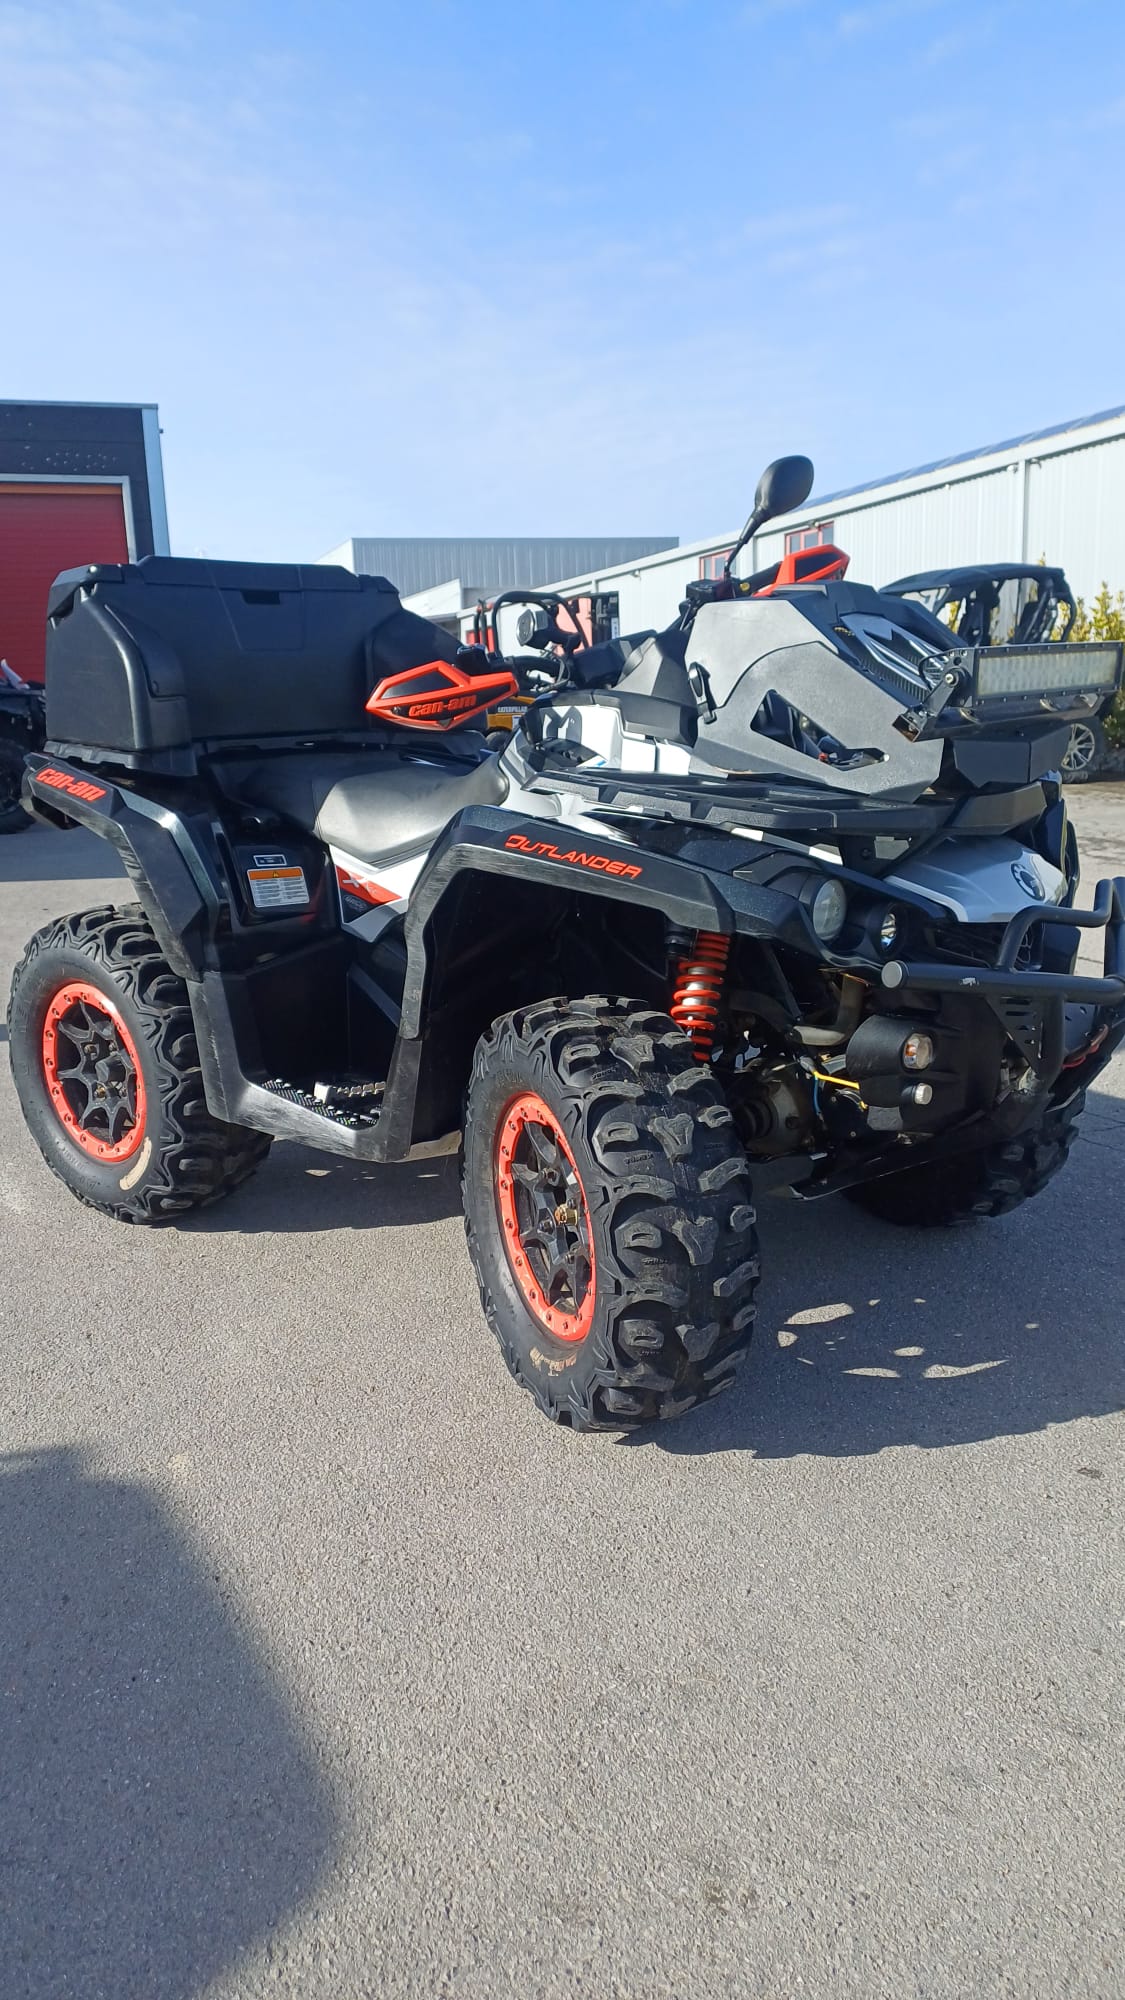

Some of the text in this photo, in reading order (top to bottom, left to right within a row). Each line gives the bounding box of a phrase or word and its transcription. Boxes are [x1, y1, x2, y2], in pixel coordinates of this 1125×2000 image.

[408, 694, 477, 717] can-am
[36, 768, 107, 802] can-am
[504, 834, 643, 879] OUTLANDER
